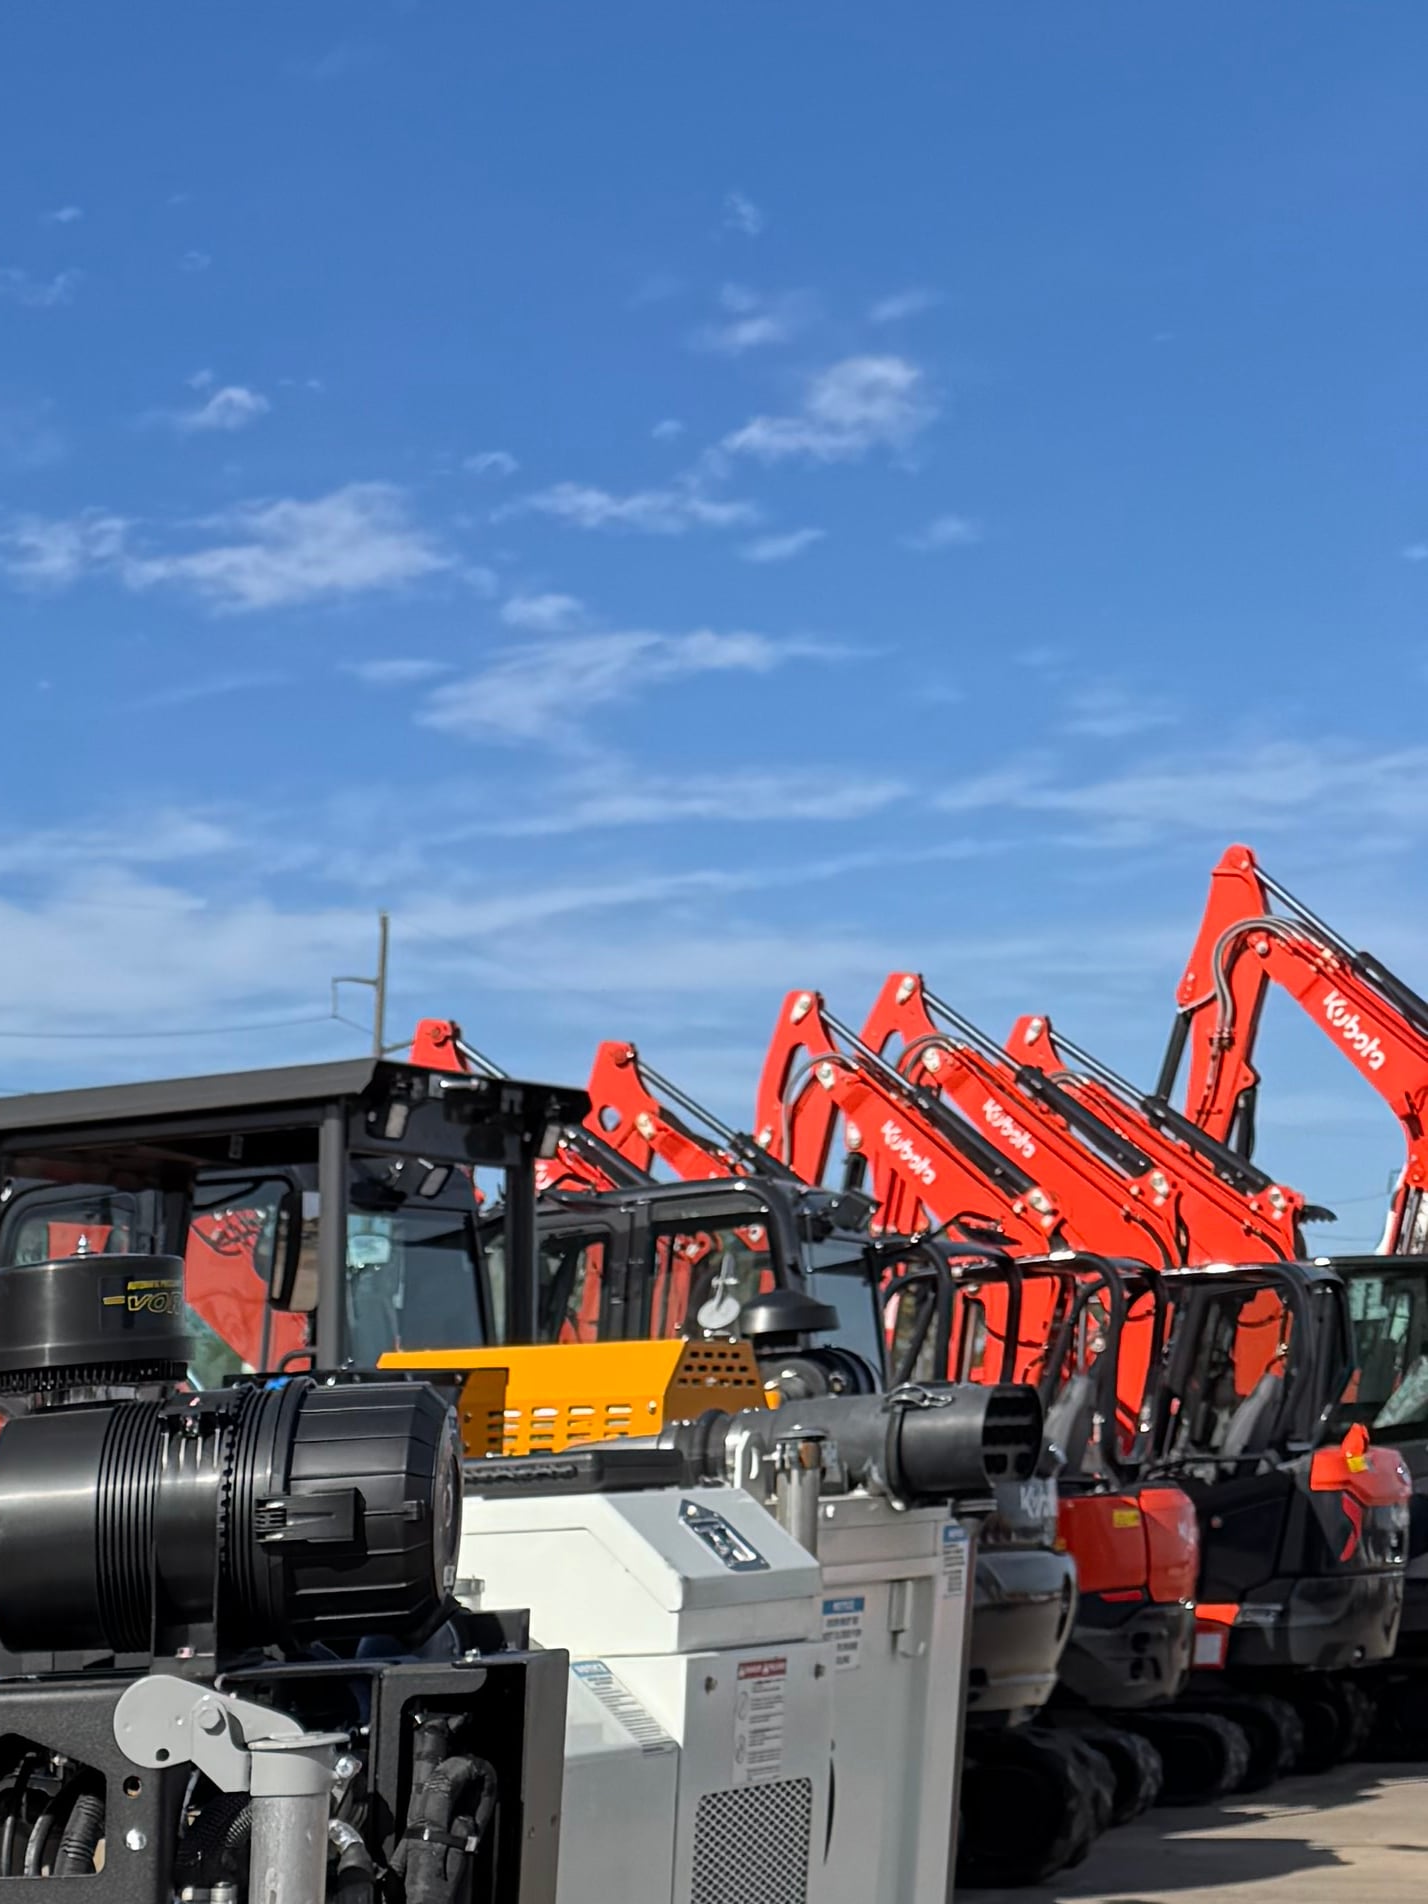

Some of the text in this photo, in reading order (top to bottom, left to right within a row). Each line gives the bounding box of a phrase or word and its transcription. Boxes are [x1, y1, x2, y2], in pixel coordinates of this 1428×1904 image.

[1323, 988, 1385, 1071] Kubota
[881, 1120, 937, 1185] Kubota
[982, 1098, 1036, 1159] Kubota
